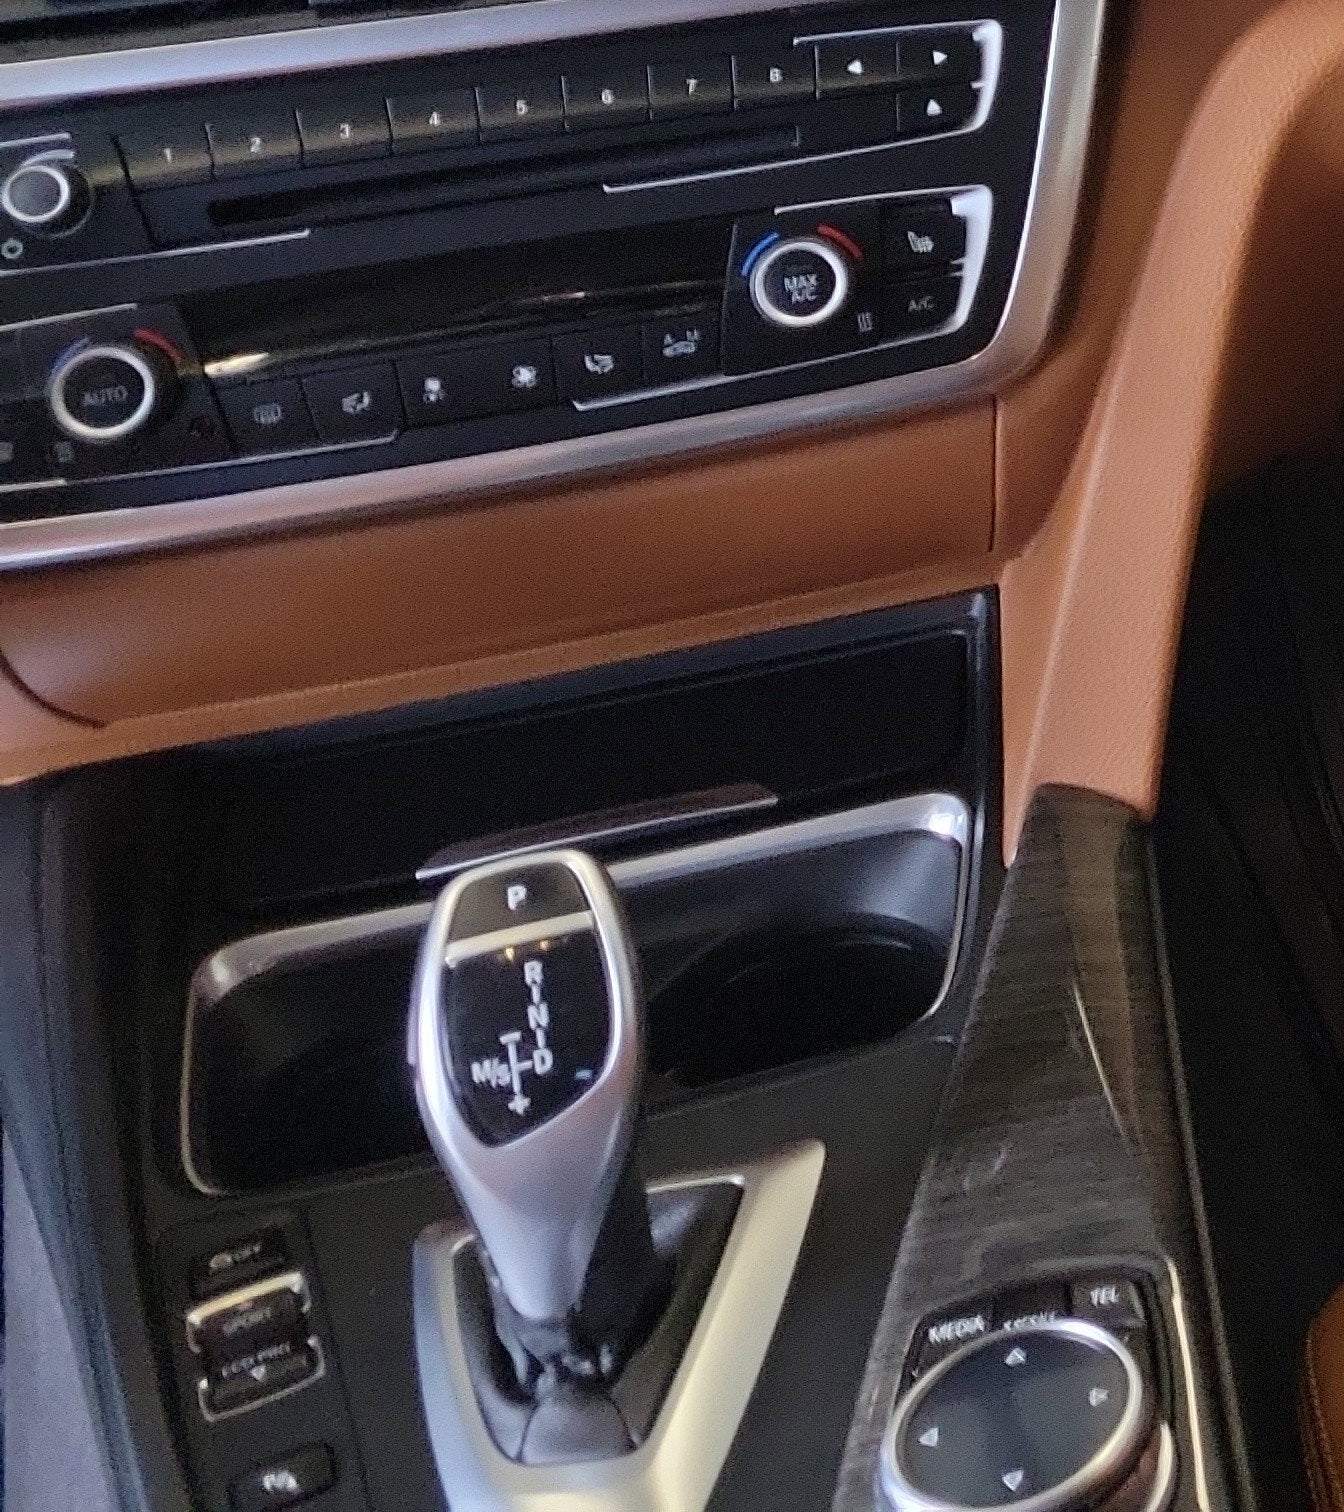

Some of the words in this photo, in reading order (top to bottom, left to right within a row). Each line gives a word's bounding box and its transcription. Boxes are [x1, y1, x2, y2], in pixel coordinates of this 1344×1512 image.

[686, 78, 699, 95] 7
[515, 100, 528, 116] 5
[428, 111, 441, 128] 4
[250, 137, 262, 153] 2
[163, 148, 173, 164] 1
[784, 273, 818, 292] MAX
[81, 385, 128, 407] AUTO
[507, 885, 527, 910] P
[523, 960, 543, 987] R
[527, 1001, 549, 1031] N
[532, 1047, 553, 1075] D
[1090, 1285, 1119, 1307] TEL
